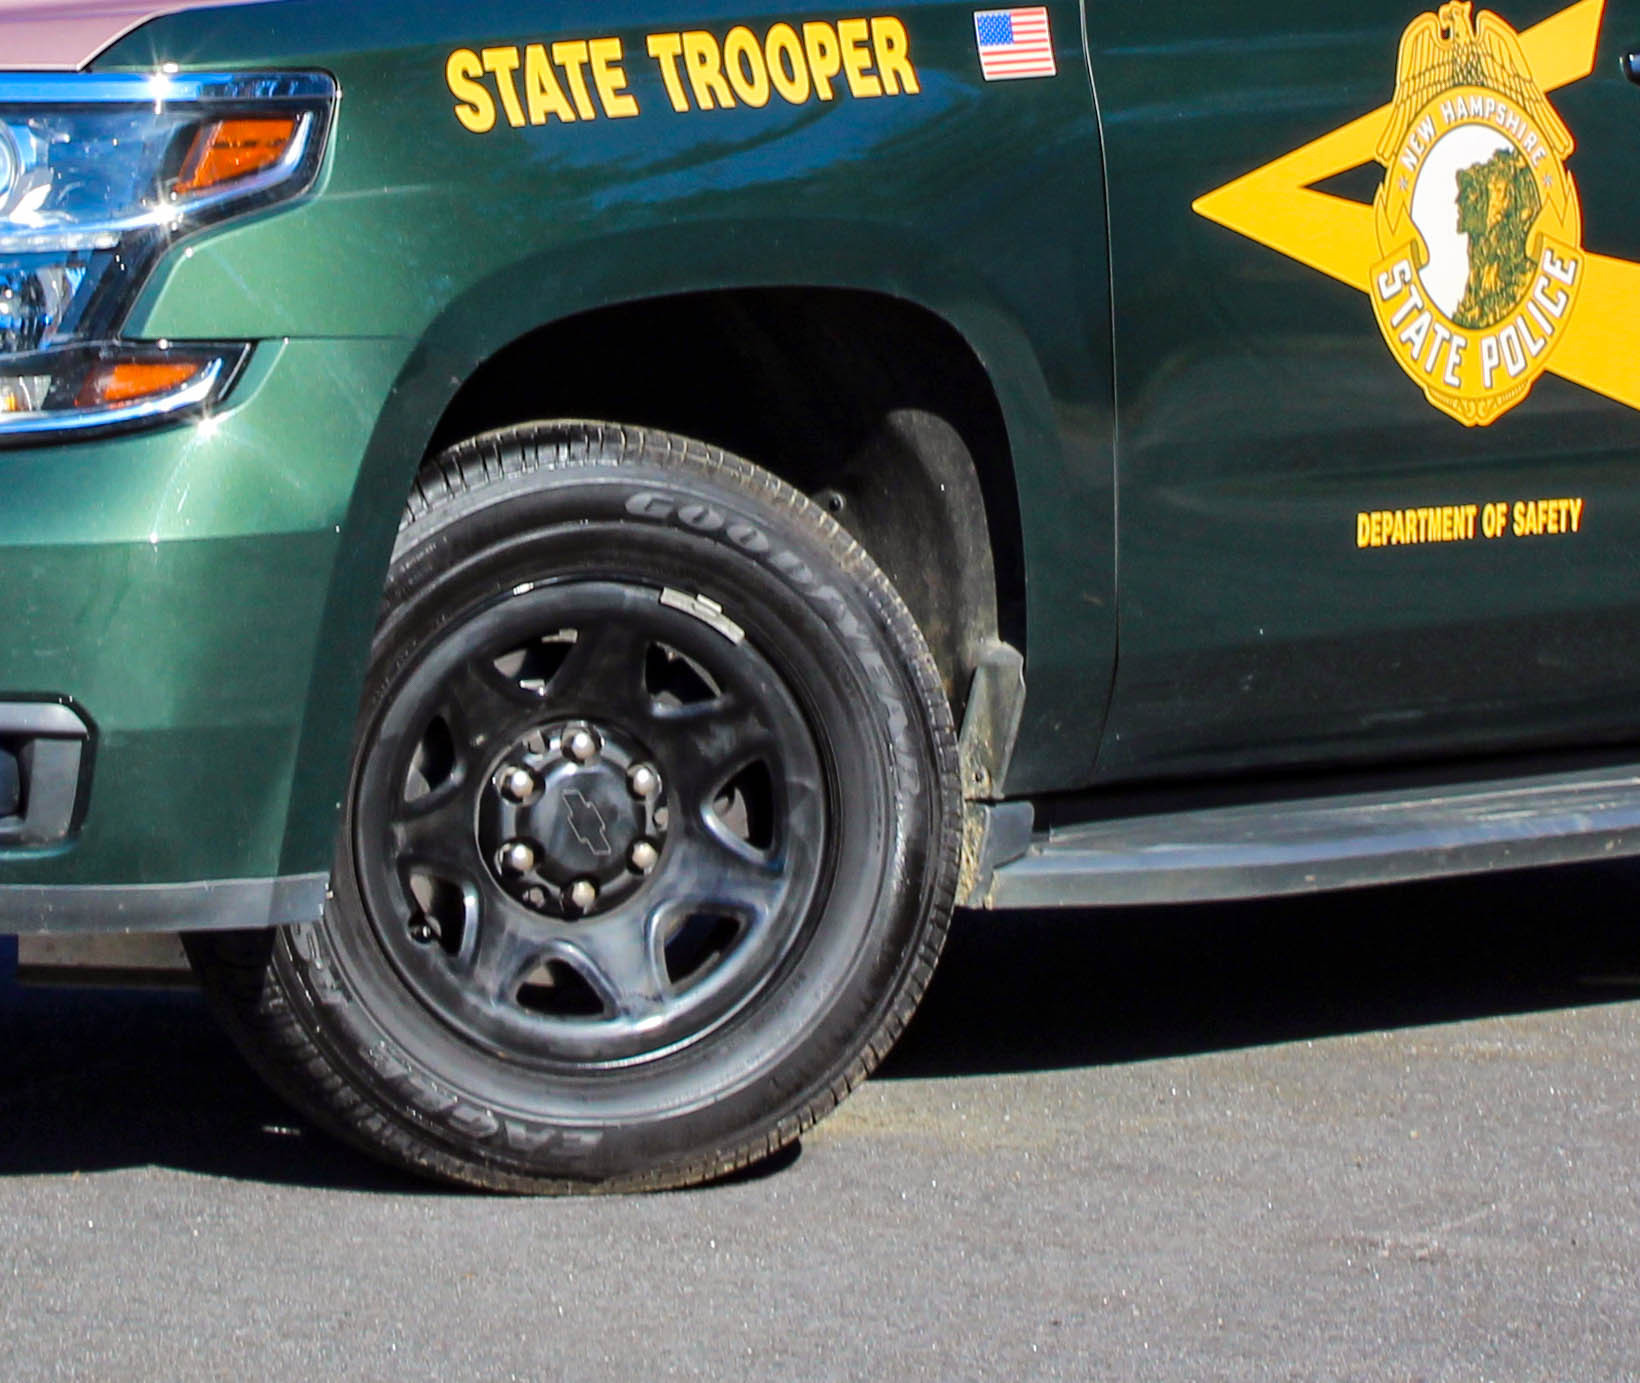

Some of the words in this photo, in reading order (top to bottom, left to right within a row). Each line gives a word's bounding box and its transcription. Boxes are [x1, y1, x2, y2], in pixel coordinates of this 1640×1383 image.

[445, 36, 639, 134] STATE
[646, 16, 920, 113] TROOPER
[1401, 114, 1437, 172] NEW
[1440, 94, 1548, 167] HAMPSHIRE
[1377, 258, 1468, 387] STATE
[1481, 247, 1577, 388] POLICE
[1356, 505, 1477, 548] DEPARTMENT
[1482, 502, 1507, 539] OF
[1512, 497, 1584, 537] SAFETY
